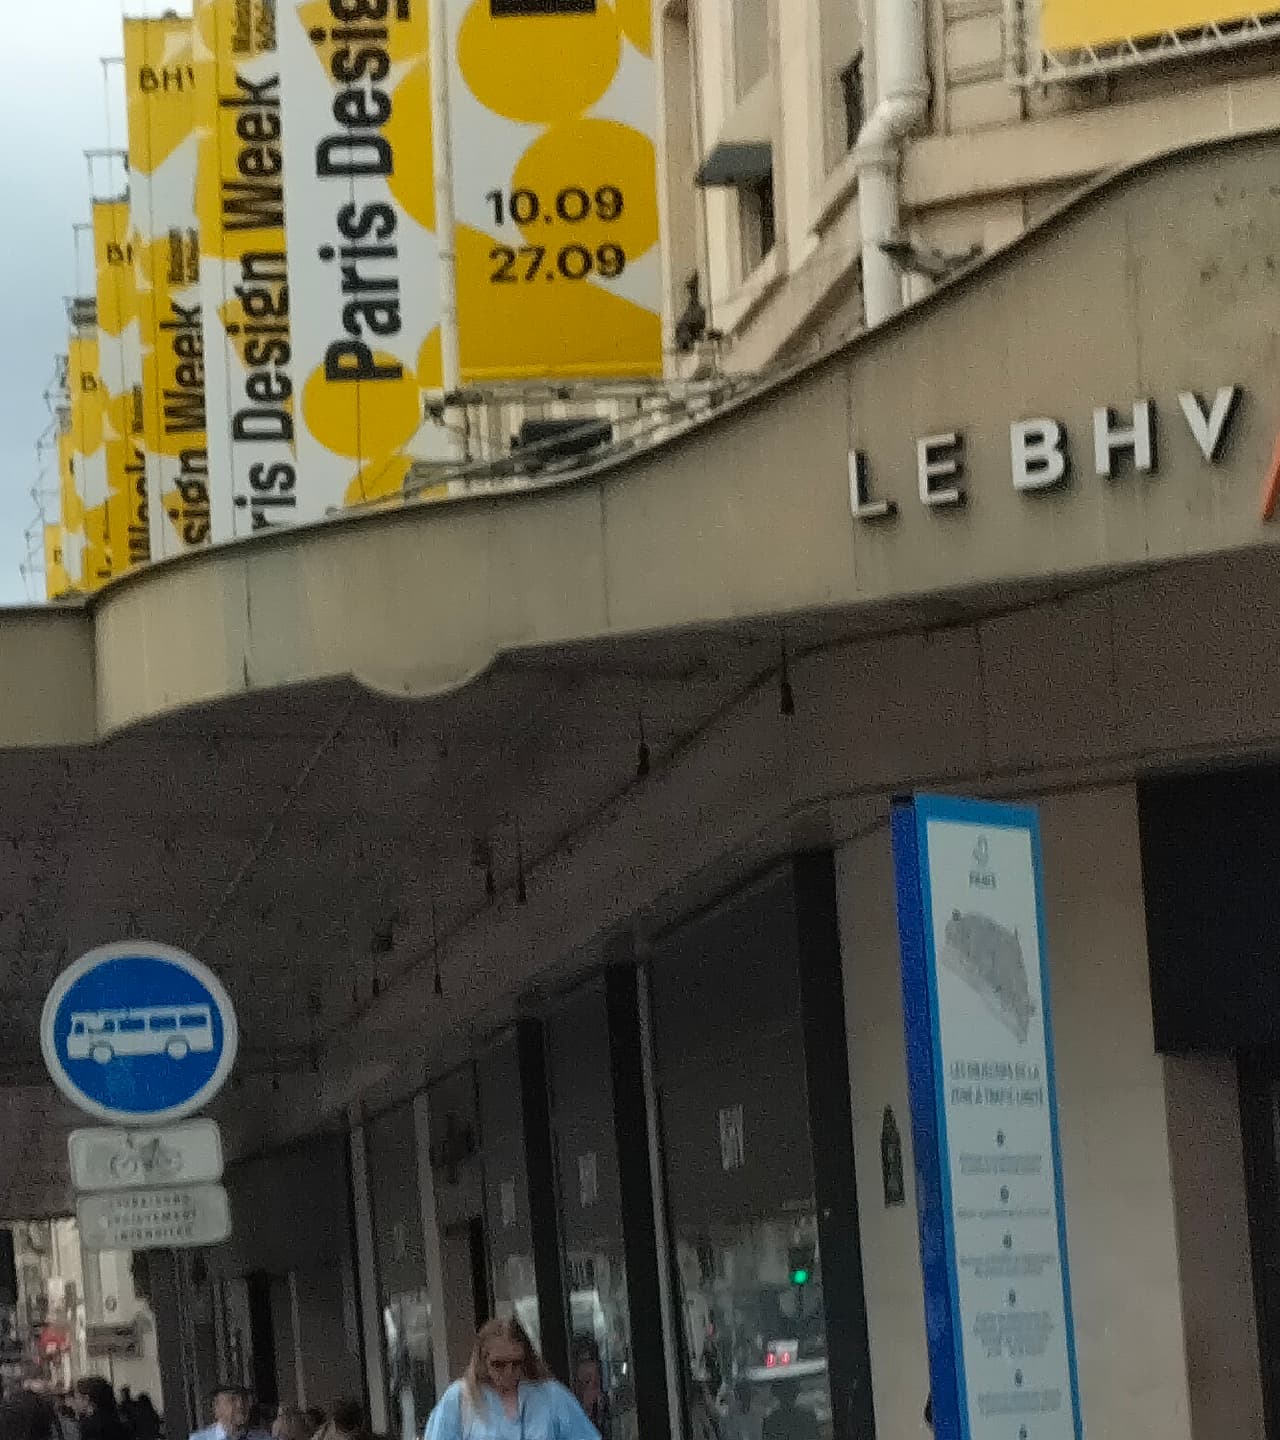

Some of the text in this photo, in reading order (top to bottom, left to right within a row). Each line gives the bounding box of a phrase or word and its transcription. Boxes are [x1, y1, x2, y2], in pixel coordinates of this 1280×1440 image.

[218, 72, 284, 232] Week
[486, 184, 624, 226] 10.09
[318, 202, 402, 381] Paris
[488, 242, 627, 284] 27.09
[159, 300, 207, 434] Week
[226, 251, 295, 442] Design
[846, 433, 965, 520] LE
